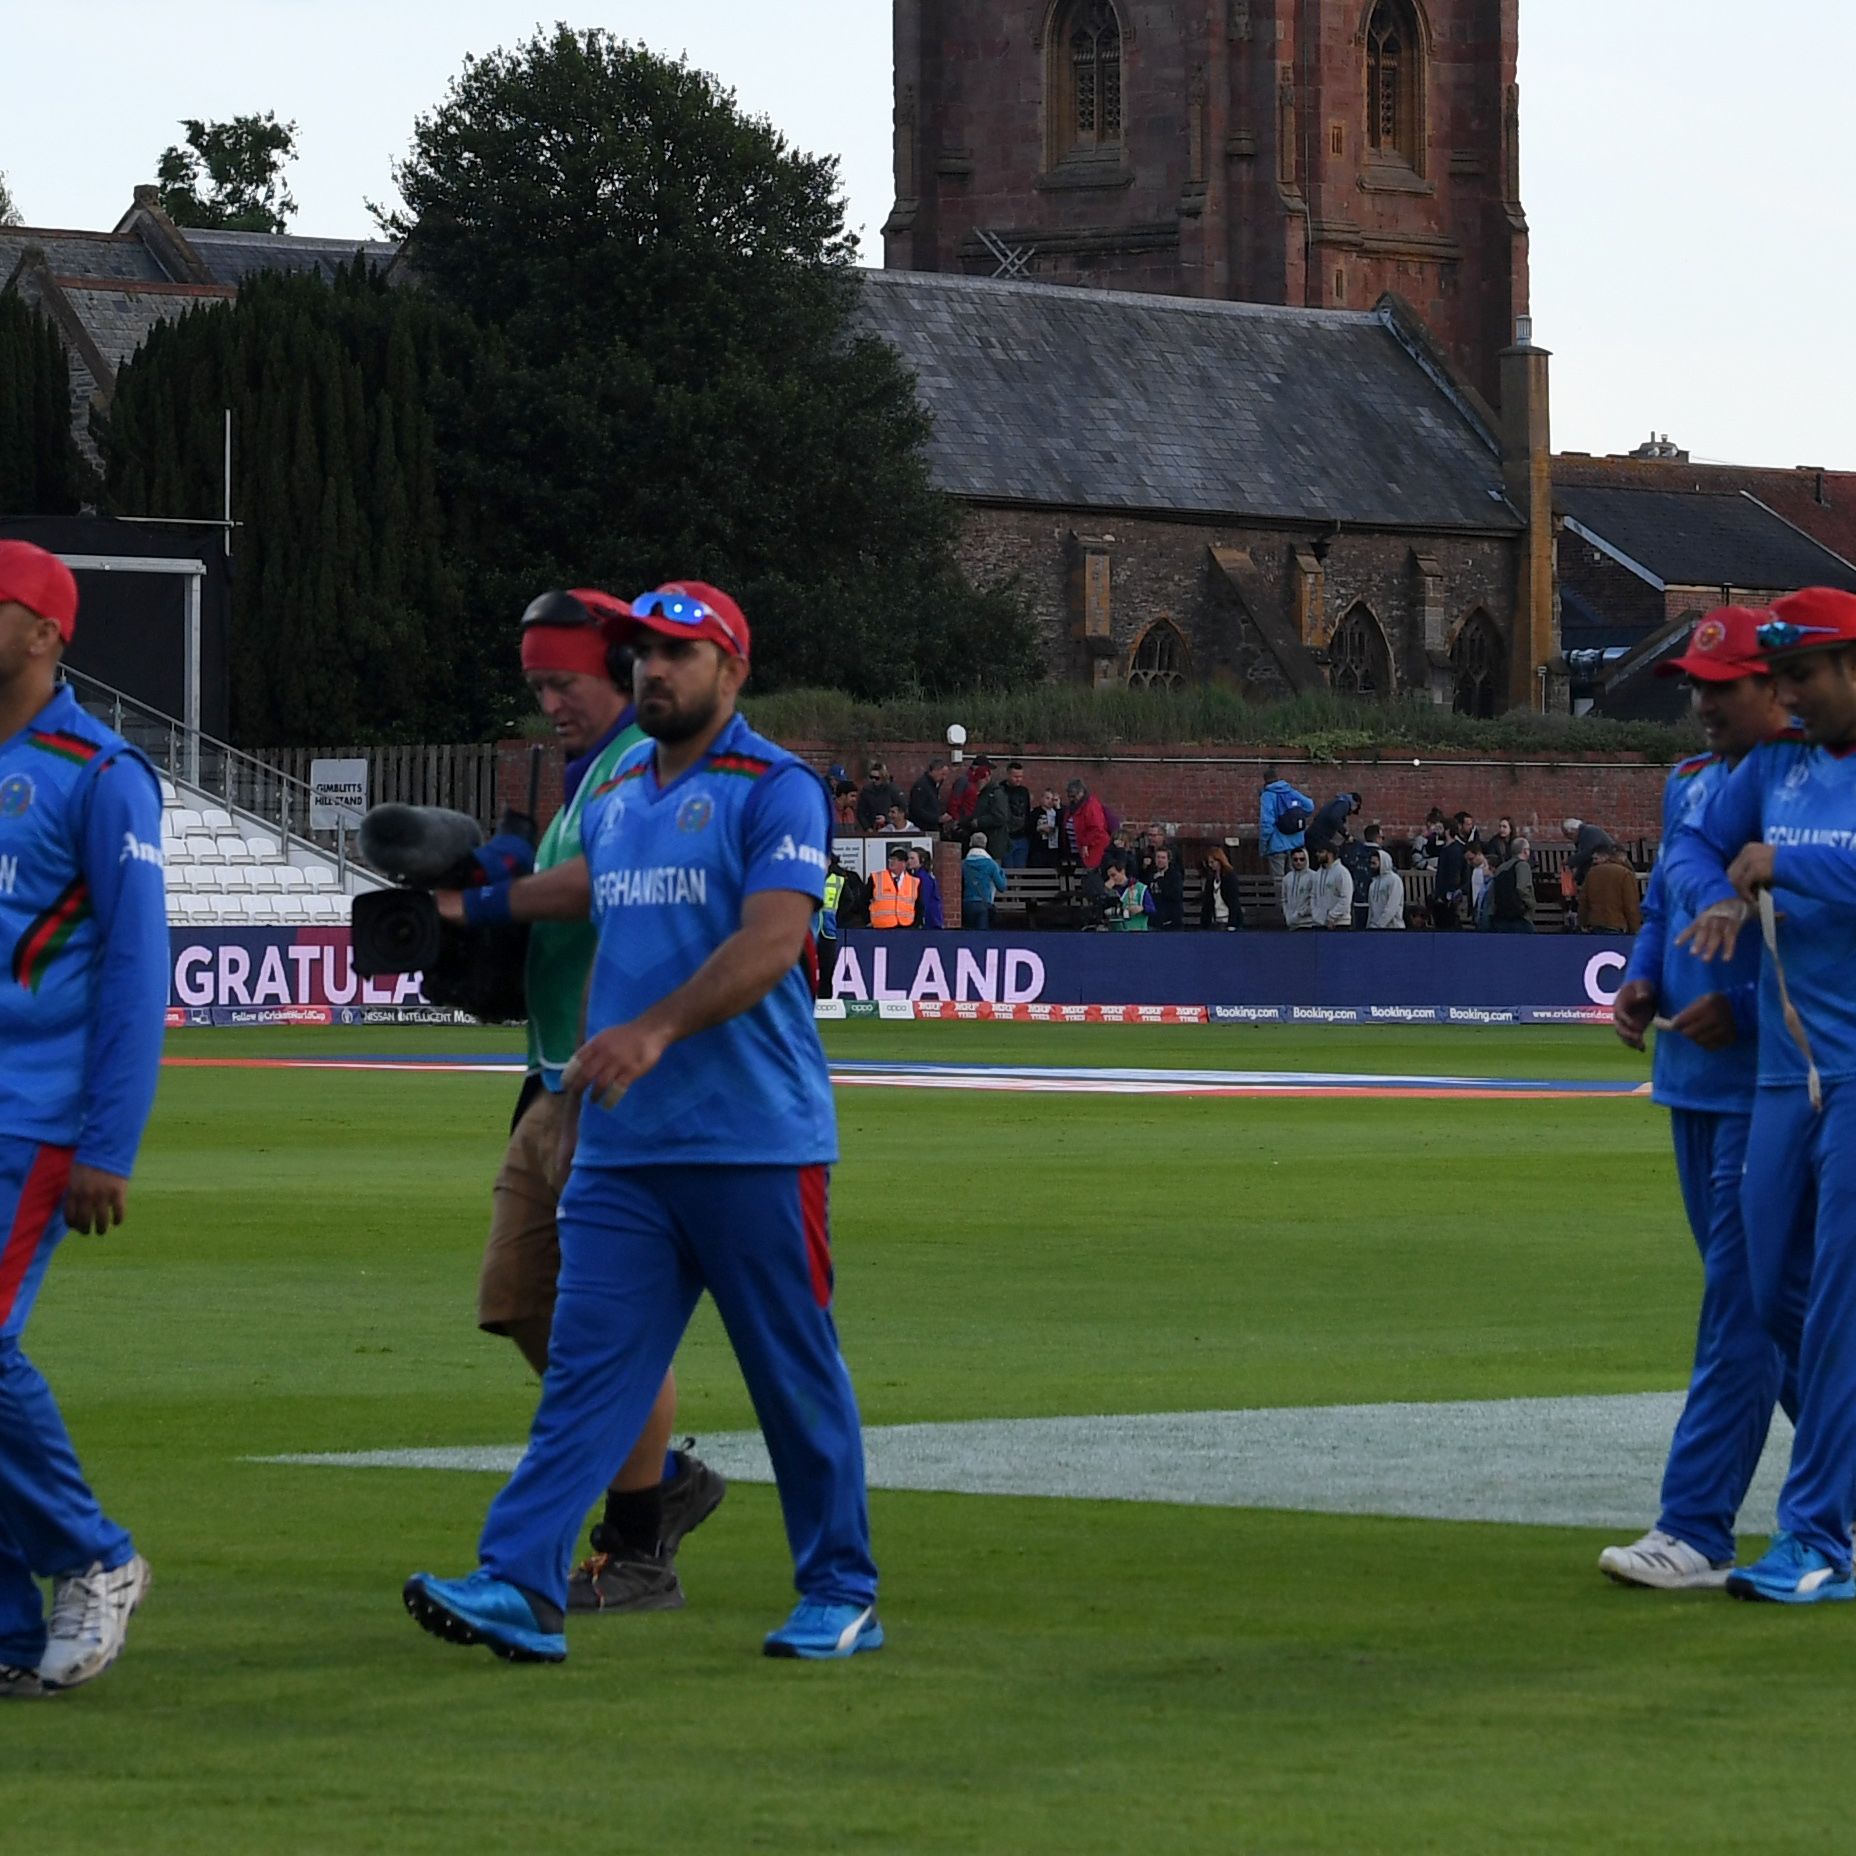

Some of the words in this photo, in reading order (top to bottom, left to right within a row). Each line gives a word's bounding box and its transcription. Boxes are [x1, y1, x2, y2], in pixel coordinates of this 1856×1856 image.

[1216, 1006, 1278, 1020] Booking.com
[1294, 1006, 1356, 1021] Booking.com
[1370, 1005, 1435, 1020] Booking.com
[1449, 1007, 1513, 1022] Booking.com
